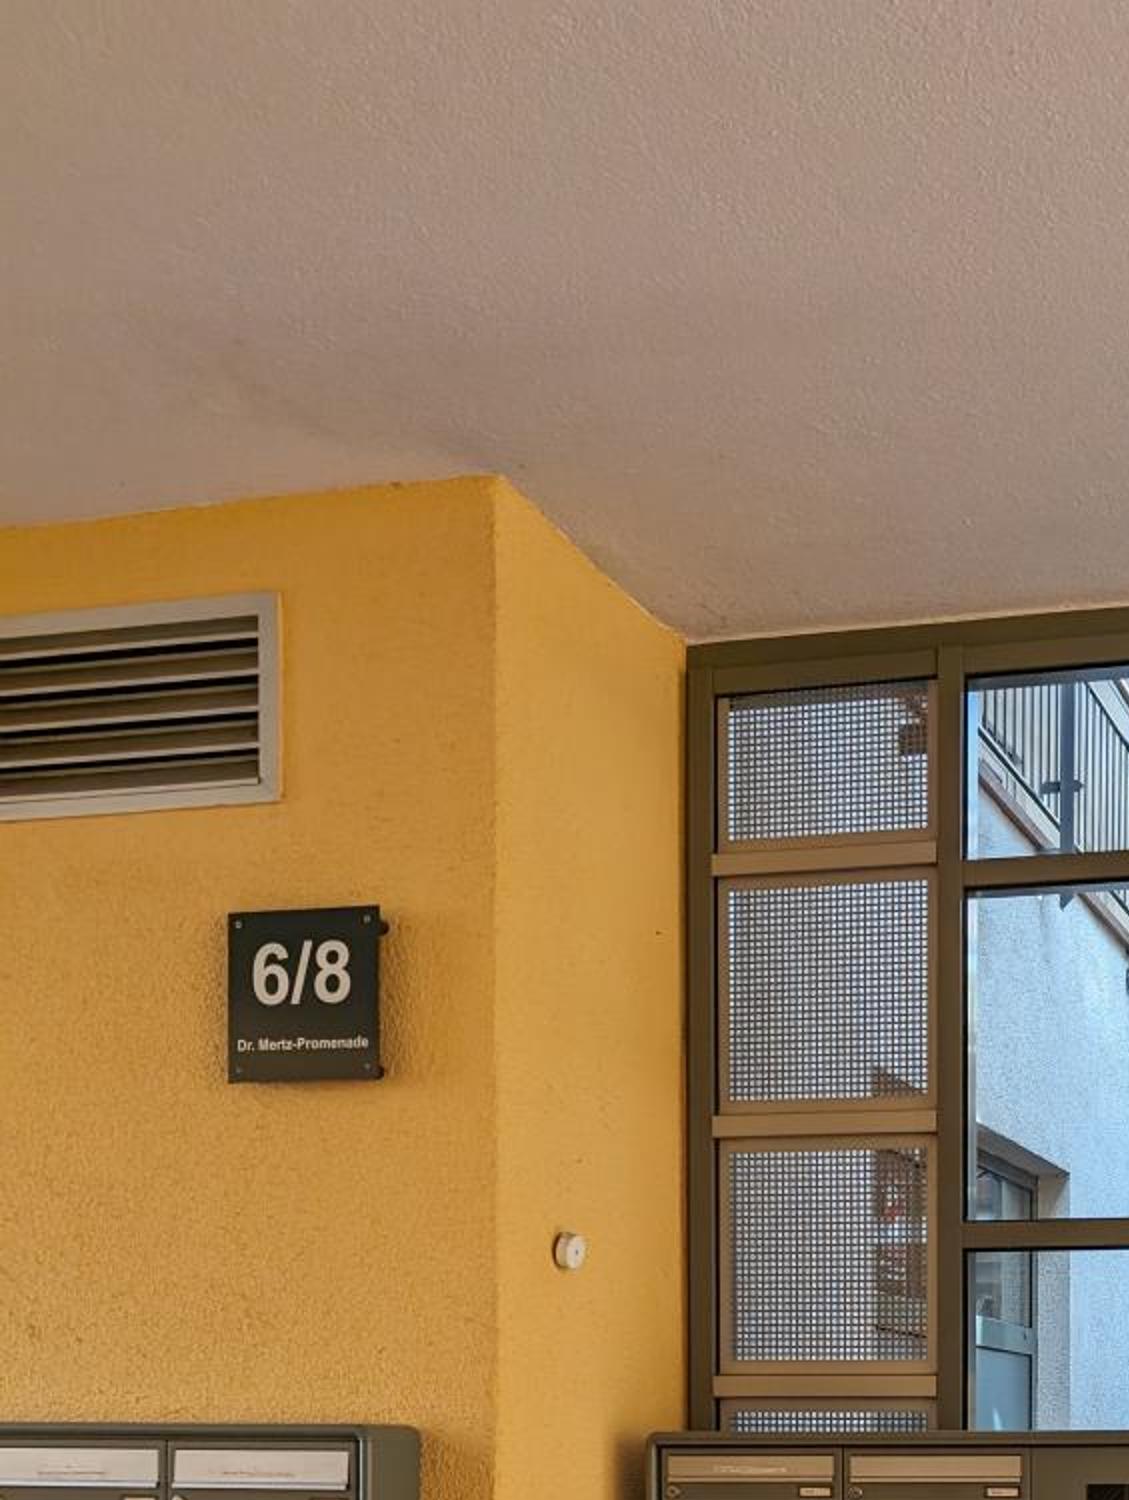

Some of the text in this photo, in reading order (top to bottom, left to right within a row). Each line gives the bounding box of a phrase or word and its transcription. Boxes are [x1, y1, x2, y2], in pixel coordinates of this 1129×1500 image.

[253, 939, 351, 1006] 6/8
[237, 1034, 369, 1052] Dr. Mertz-Promenade
